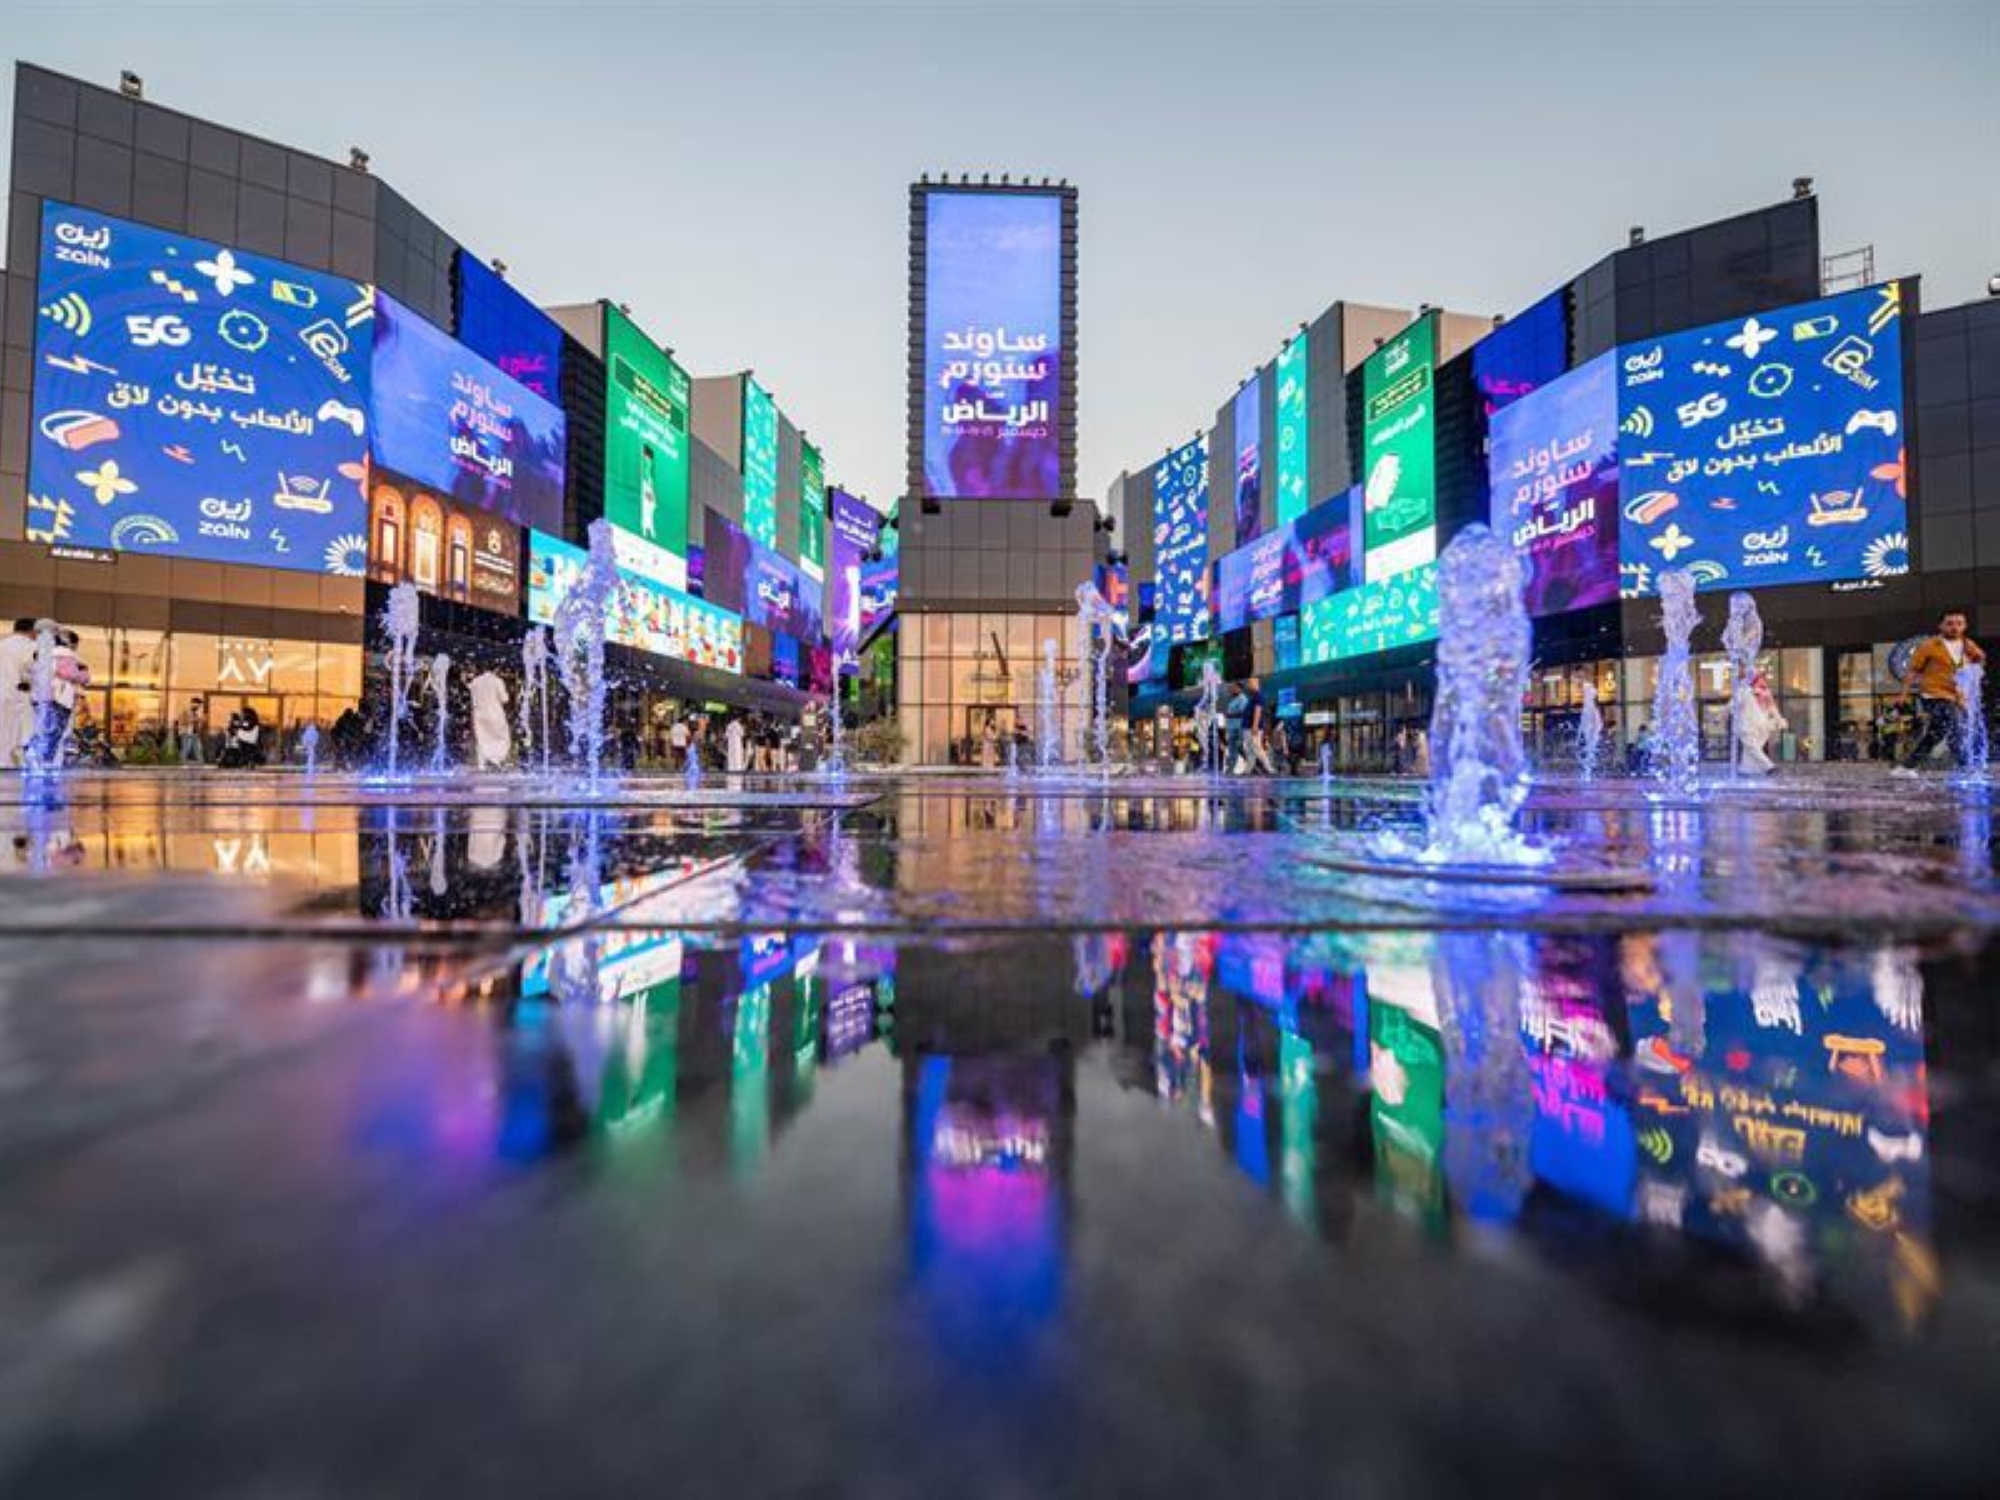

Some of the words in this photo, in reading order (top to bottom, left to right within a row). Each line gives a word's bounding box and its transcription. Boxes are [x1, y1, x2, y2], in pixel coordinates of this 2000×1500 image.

[55, 222, 110, 247] زين
[127, 315, 192, 346] 5G
[942, 326, 1048, 358] ساوند
[938, 356, 1048, 387] ستورم
[1625, 345, 1663, 369] زين
[106, 382, 149, 408] لاق
[157, 396, 223, 423] بدون
[231, 404, 314, 435] الألعاب
[942, 398, 1049, 427] الرياض
[1677, 392, 1728, 429] 5G
[1511, 428, 1593, 480] ساوند
[1763, 431, 1844, 466] الألعاب
[1666, 457, 1699, 484] لاق
[1704, 452, 1758, 476] بدون
[1511, 459, 1593, 515] ستورم
[199, 497, 252, 520] زين
[1512, 497, 1595, 547] الرياض
[1742, 526, 1790, 551] زين
